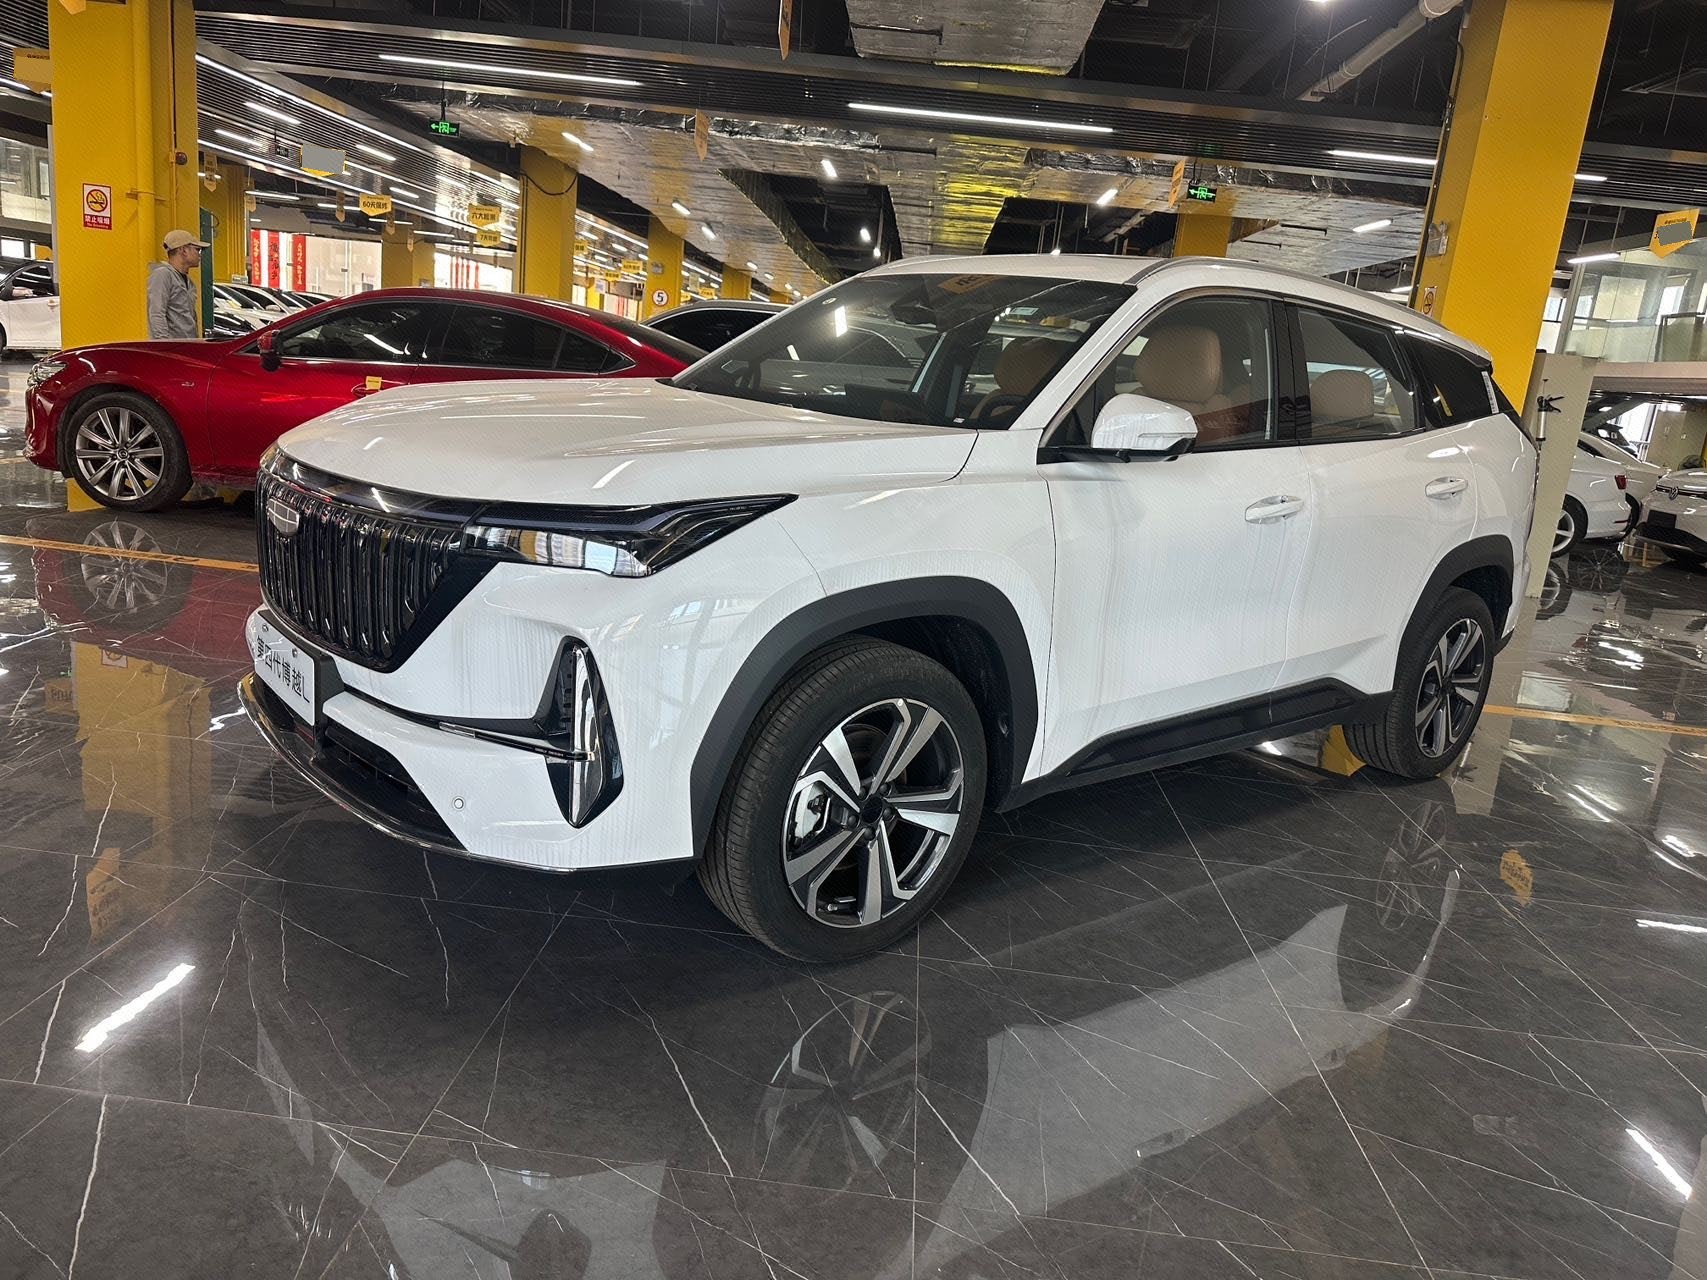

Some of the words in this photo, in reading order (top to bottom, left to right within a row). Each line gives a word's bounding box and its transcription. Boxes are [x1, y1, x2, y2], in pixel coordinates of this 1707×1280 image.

[656, 292, 664, 303] 5
[256, 635, 311, 704] 第四代博越L
